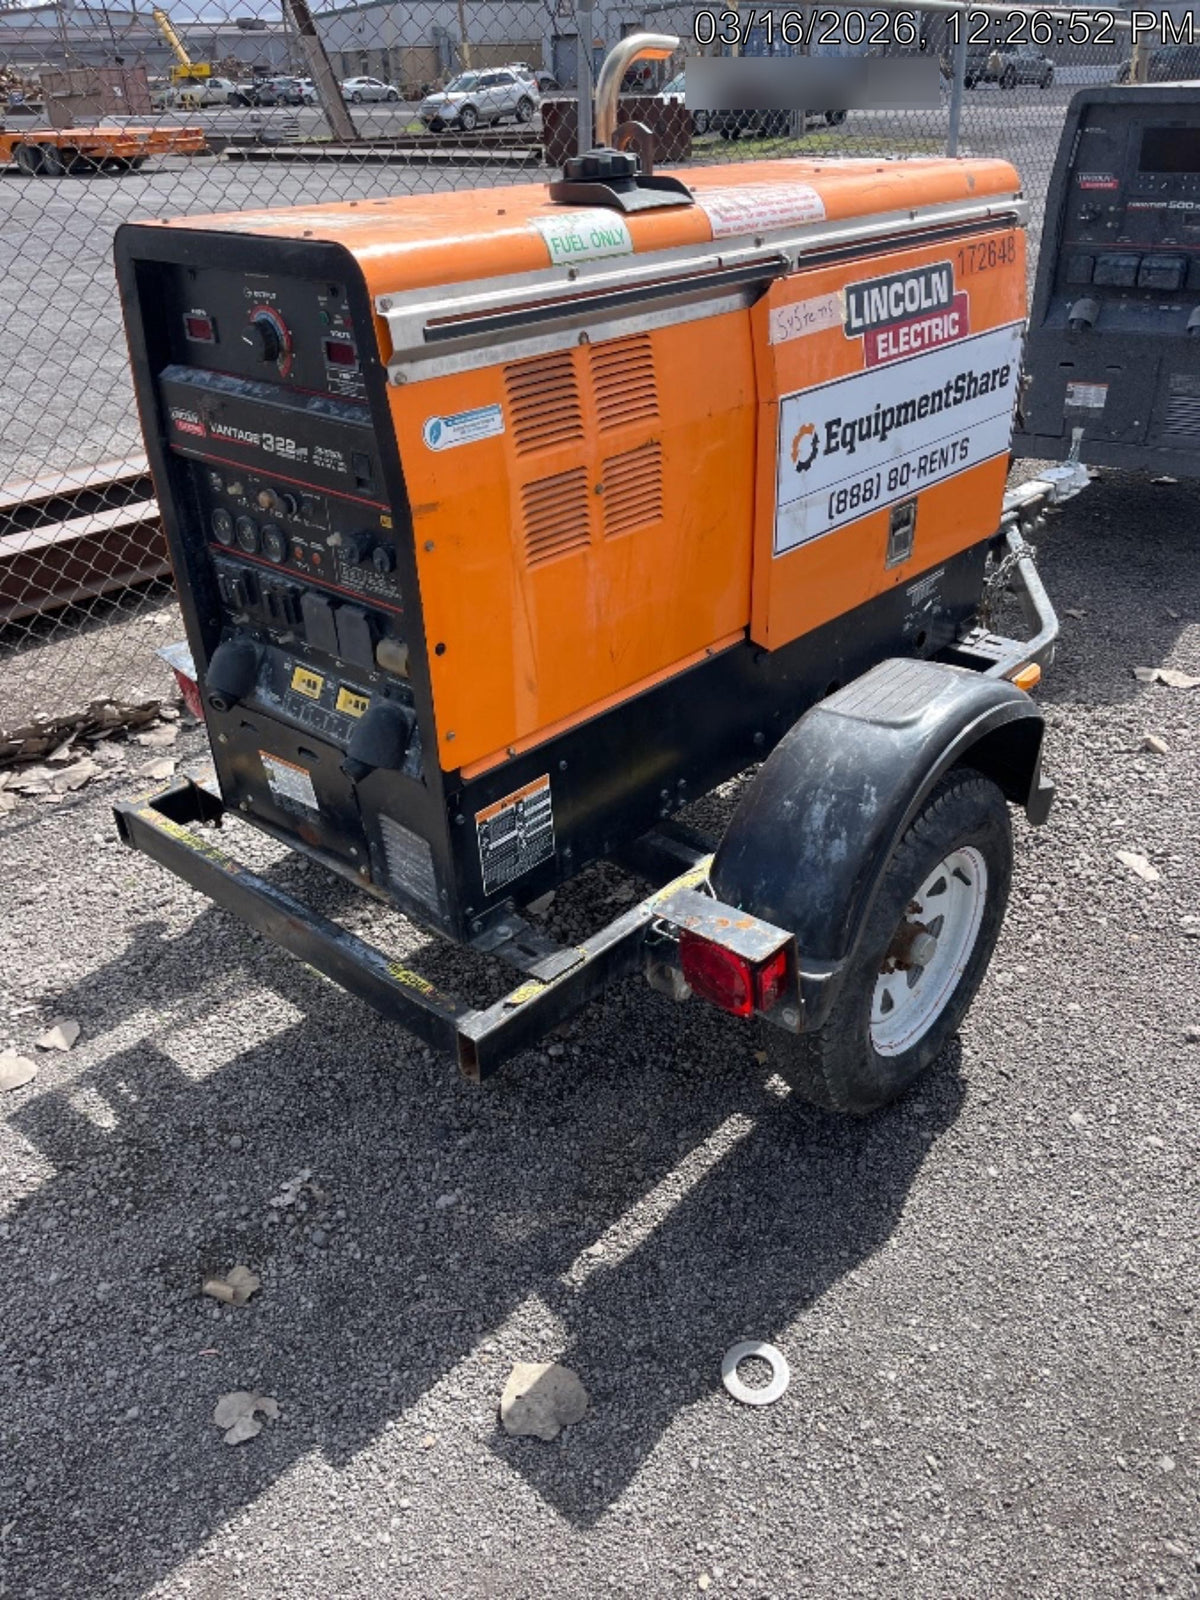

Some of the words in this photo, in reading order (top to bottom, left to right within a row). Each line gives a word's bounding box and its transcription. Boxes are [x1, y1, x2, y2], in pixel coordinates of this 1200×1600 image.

[1168, 201, 1195, 209] 500
[550, 232, 590, 255] FUEL
[590, 228, 625, 249] ONLY
[957, 235, 1016, 276] 172648
[849, 269, 949, 330] LINCOLN
[876, 311, 960, 360] ELECTRIC
[823, 364, 1010, 456] EquipmentShare
[210, 421, 261, 446] VANTAGE
[262, 432, 296, 454] 322
[827, 472, 882, 520] (888)
[886, 437, 970, 492] 80-RENTS
